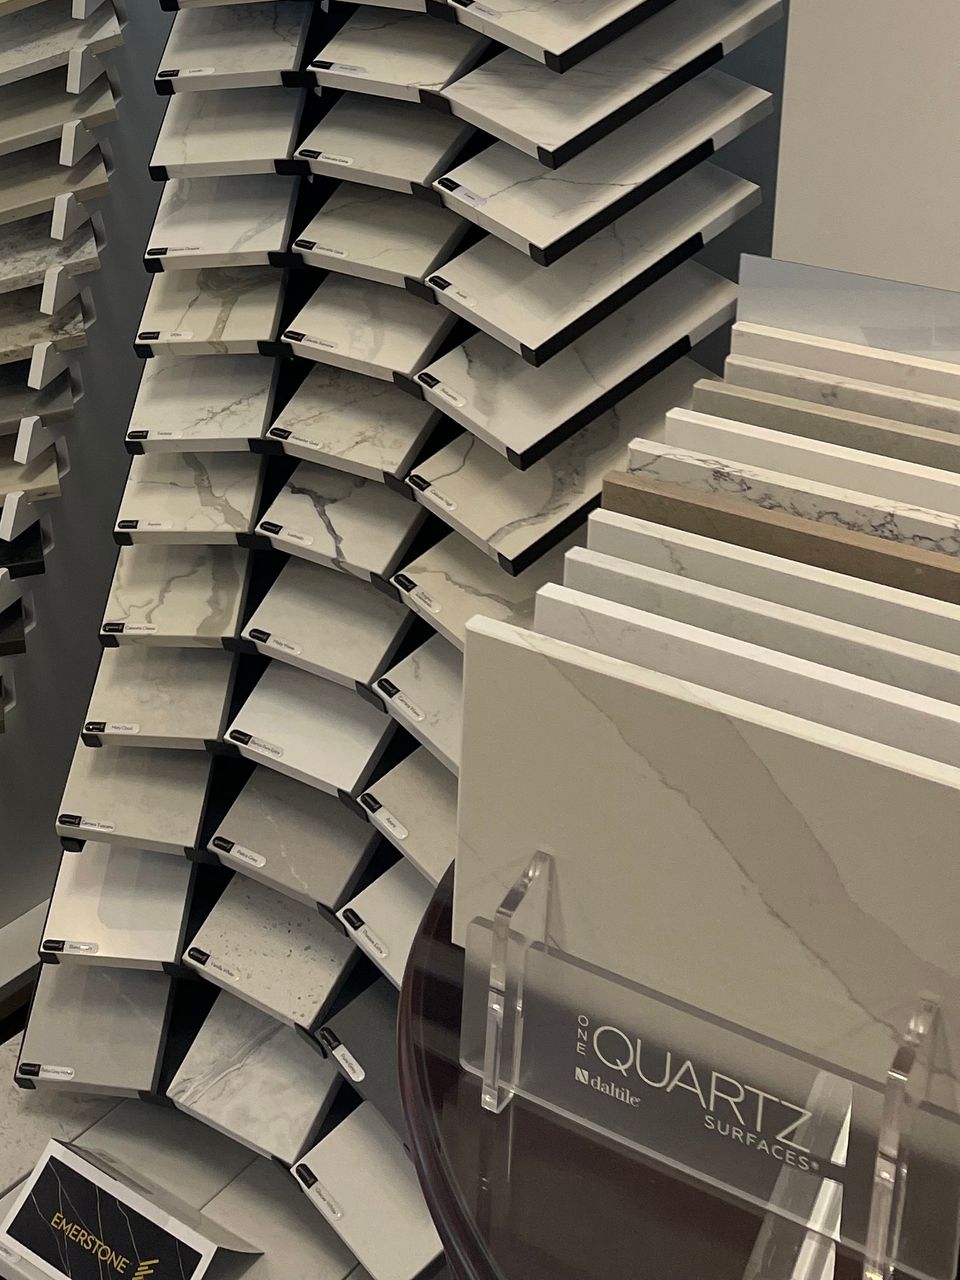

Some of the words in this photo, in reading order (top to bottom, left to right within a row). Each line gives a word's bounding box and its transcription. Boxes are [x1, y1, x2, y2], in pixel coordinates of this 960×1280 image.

[576, 1014, 589, 1056] ONE
[590, 1076, 640, 1108] daltile
[593, 1026, 816, 1153] QUARTZ
[50, 1211, 130, 1275] EMERSTONE
